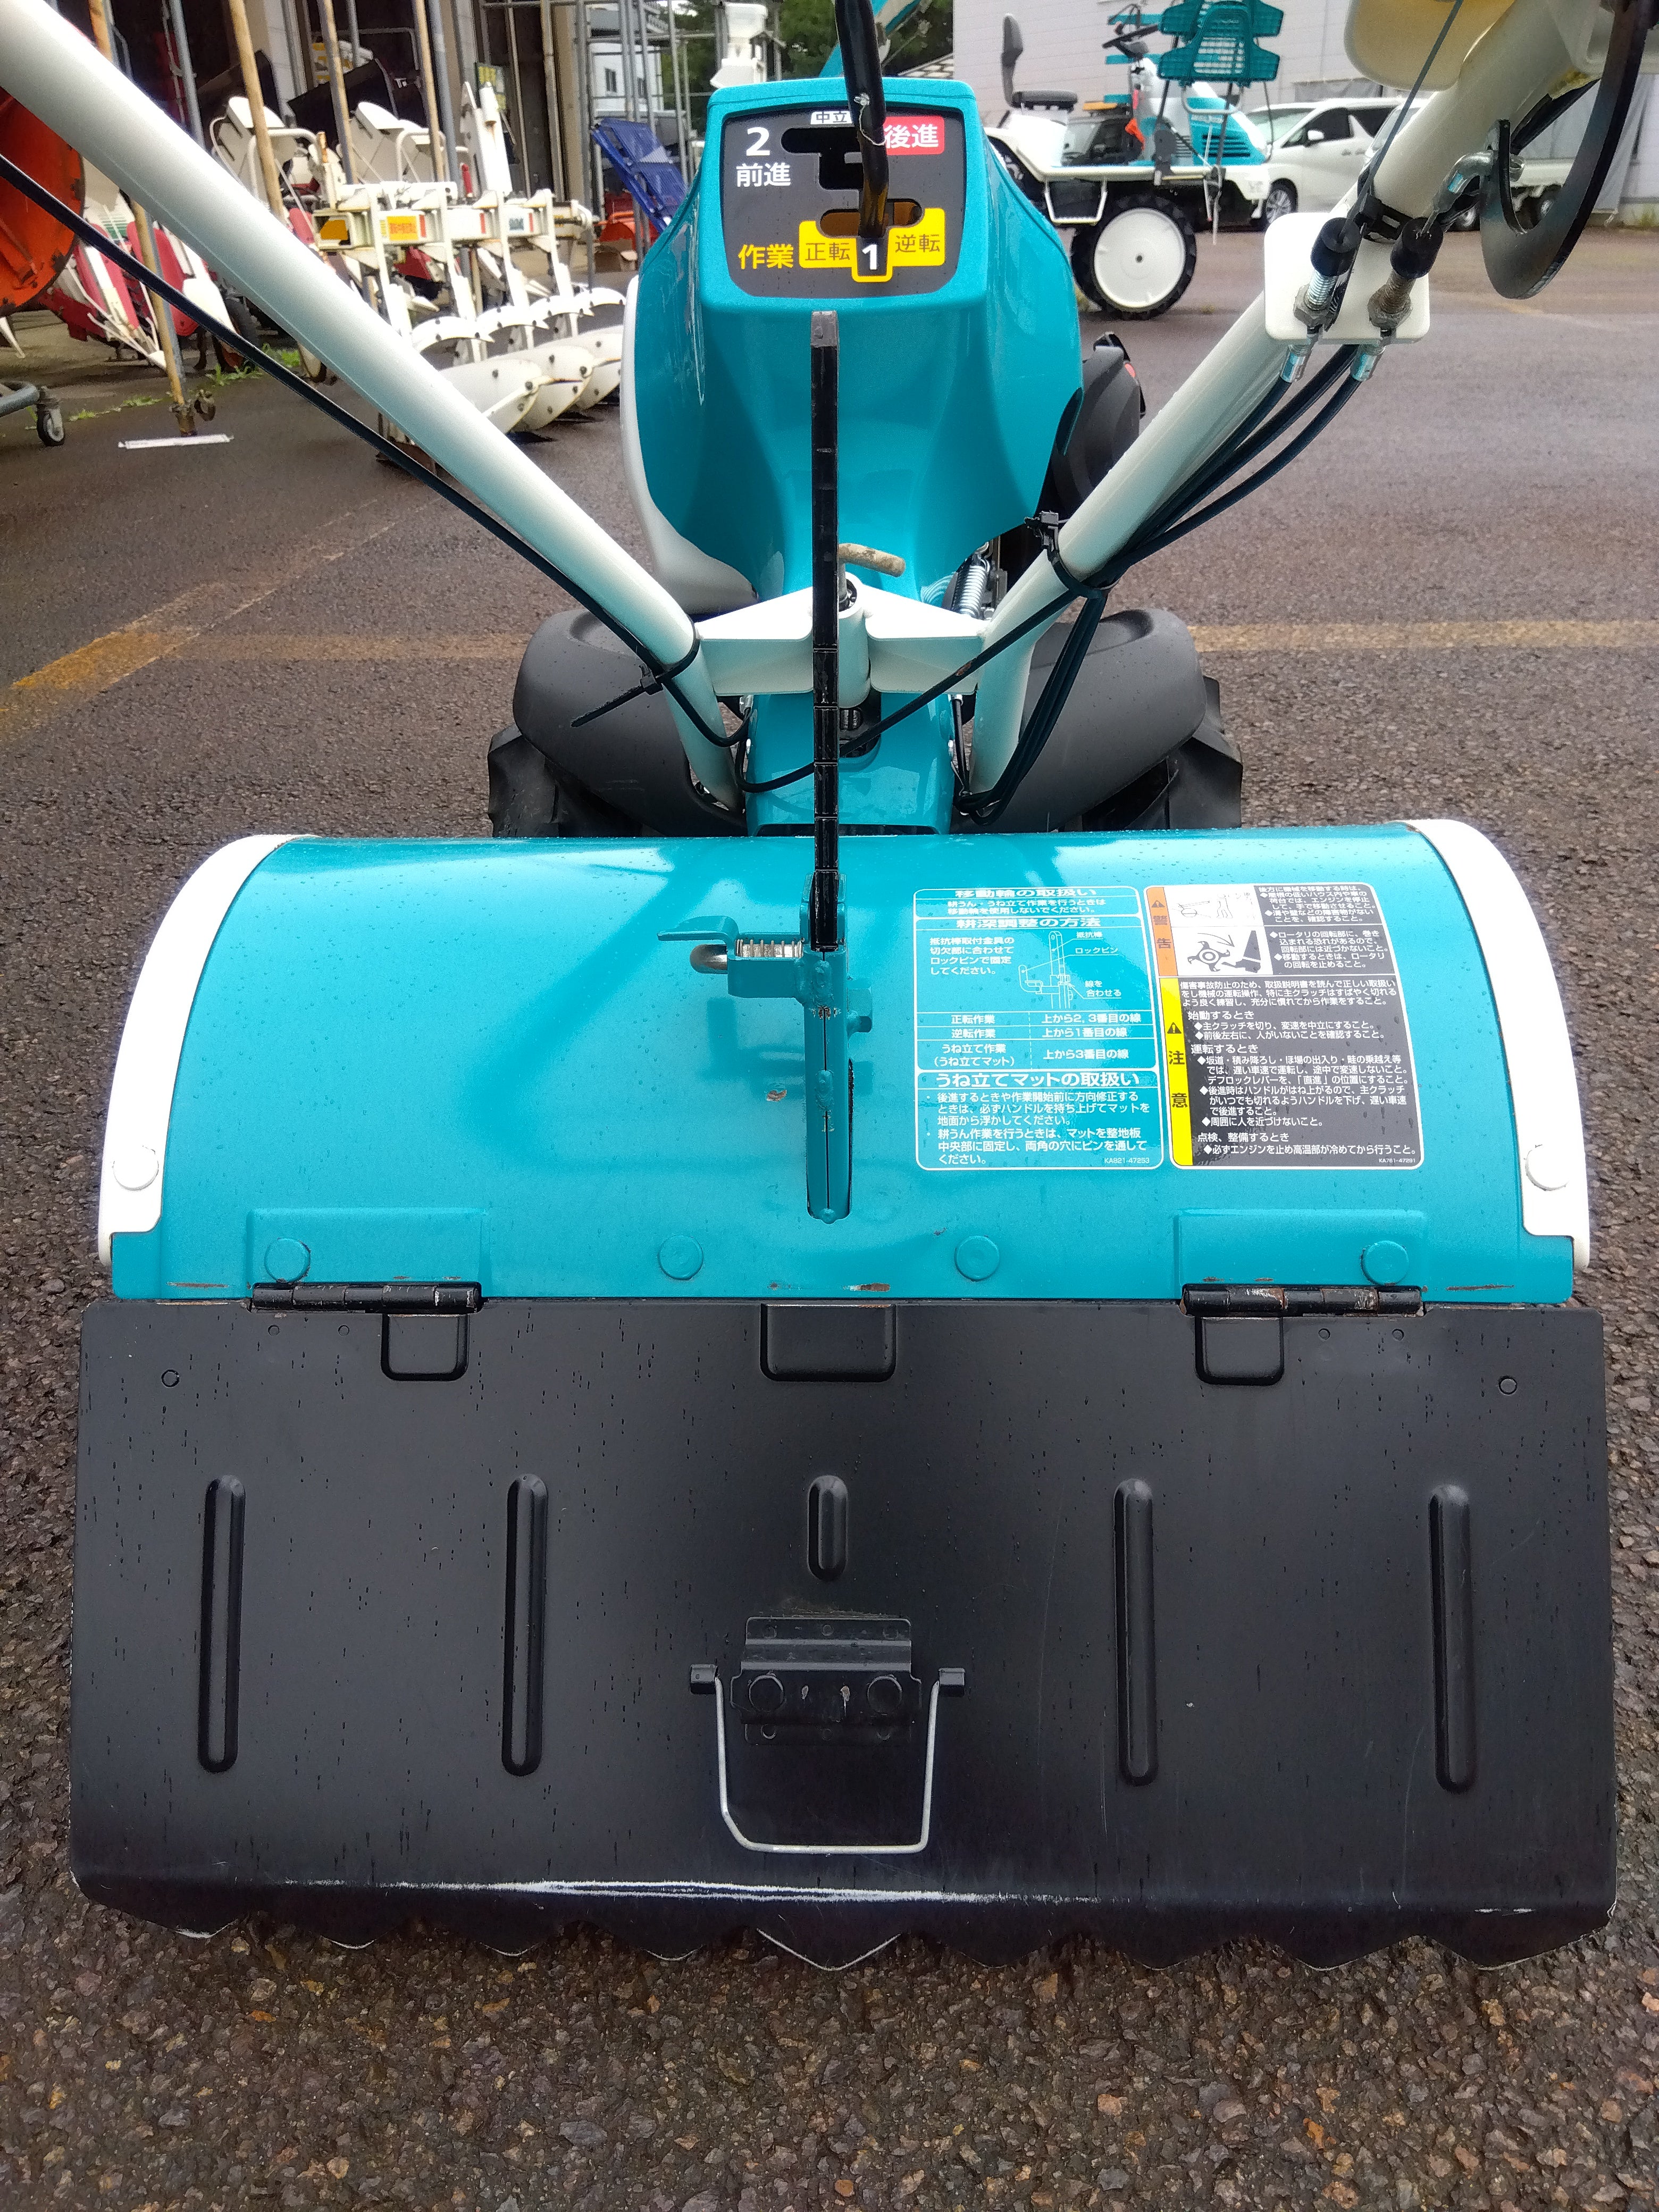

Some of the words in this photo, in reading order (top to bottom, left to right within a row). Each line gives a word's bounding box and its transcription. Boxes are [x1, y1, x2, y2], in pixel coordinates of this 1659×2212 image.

[816, 112, 848, 123] 中立
[746, 127, 770, 156] 2
[884, 124, 939, 149] 後進
[736, 163, 791, 187] 前進
[895, 234, 941, 254] 逆転
[805, 242, 850, 261] 正転
[739, 244, 794, 270] 作業
[862, 244, 878, 270] 1
[956, 889, 1096, 899] 移動輪の取扱い
[956, 918, 1101, 928] 耕深調整の方法
[1152, 915, 1172, 950] 警告
[1279, 930, 1380, 939] ロータリの回転部に、巻き
[929, 936, 1015, 945] 抵抗棒取付金具の
[1279, 937, 1379, 946] 込まれる恐れがあるので、
[930, 946, 1013, 955] 切欠部に合わせて
[1281, 945, 1389, 953] 回転部には近づかないこと。
[931, 956, 1012, 965] ロックピンで固定
[1282, 952, 1385, 961] 移動するときは、ロータリ
[1284, 960, 1367, 969] の回転を止めること。
[931, 966, 996, 975] してください。
[1180, 979, 1396, 990] 傷害事故防止のため、取扱説明書を読んで正しい取扱い
[1182, 997, 1388, 1007] よう良く練習し、充分に慣れてから作業をすること。
[951, 1015, 995, 1024] 正転作業
[1188, 1011, 1255, 1021] 始動するとき
[1203, 1021, 1375, 1031] 主クラッチを切り、変速を中立にすること。
[951, 1029, 996, 1038] 逆転作業
[1042, 1027, 1128, 1038] 上から1番目の線
[1203, 1030, 1385, 1040] 前後左右に、人がいないことを確認すること。
[942, 1044, 1006, 1054] うね立て作業
[1191, 1044, 1259, 1054] 運転するとき
[1043, 1049, 1129, 1060] 上から3番目の線
[1206, 1065, 1407, 1075] では、遅い車速で運転し、途中で変速しないこと。
[936, 1073, 1139, 1088] うね立てマットの取扱い
[1168, 1050, 1188, 1109] 注意
[1208, 1085, 1405, 1095] 後進時はハンドルがはね上がるので、主クラッチ
[937, 1092, 1138, 1103] 後進するときや作業開始前に方向修正する
[1209, 1095, 1407, 1106] がいつでも切れるようハンドルを下げ、遅い車速
[938, 1103, 1150, 1114] ときは、必ずハンドルを持ち上げてマットを
[1210, 1107, 1278, 1117] で後進すること。
[937, 1116, 1070, 1126] 地面から浮かしてください。
[1210, 1117, 1323, 1127] 周囲に人を近づけないこと。
[937, 1127, 1142, 1139] 耕うん作業を行うときは、マットを整地板
[1197, 1132, 1290, 1143] 点検、整備するとき
[938, 1141, 1147, 1152] 中央部に固定し、両角の穴にピンを通して
[1212, 1144, 1416, 1155] 必ずエンジンを止め高温部が冷めてから行うこと。
[939, 1154, 987, 1164] ください。
